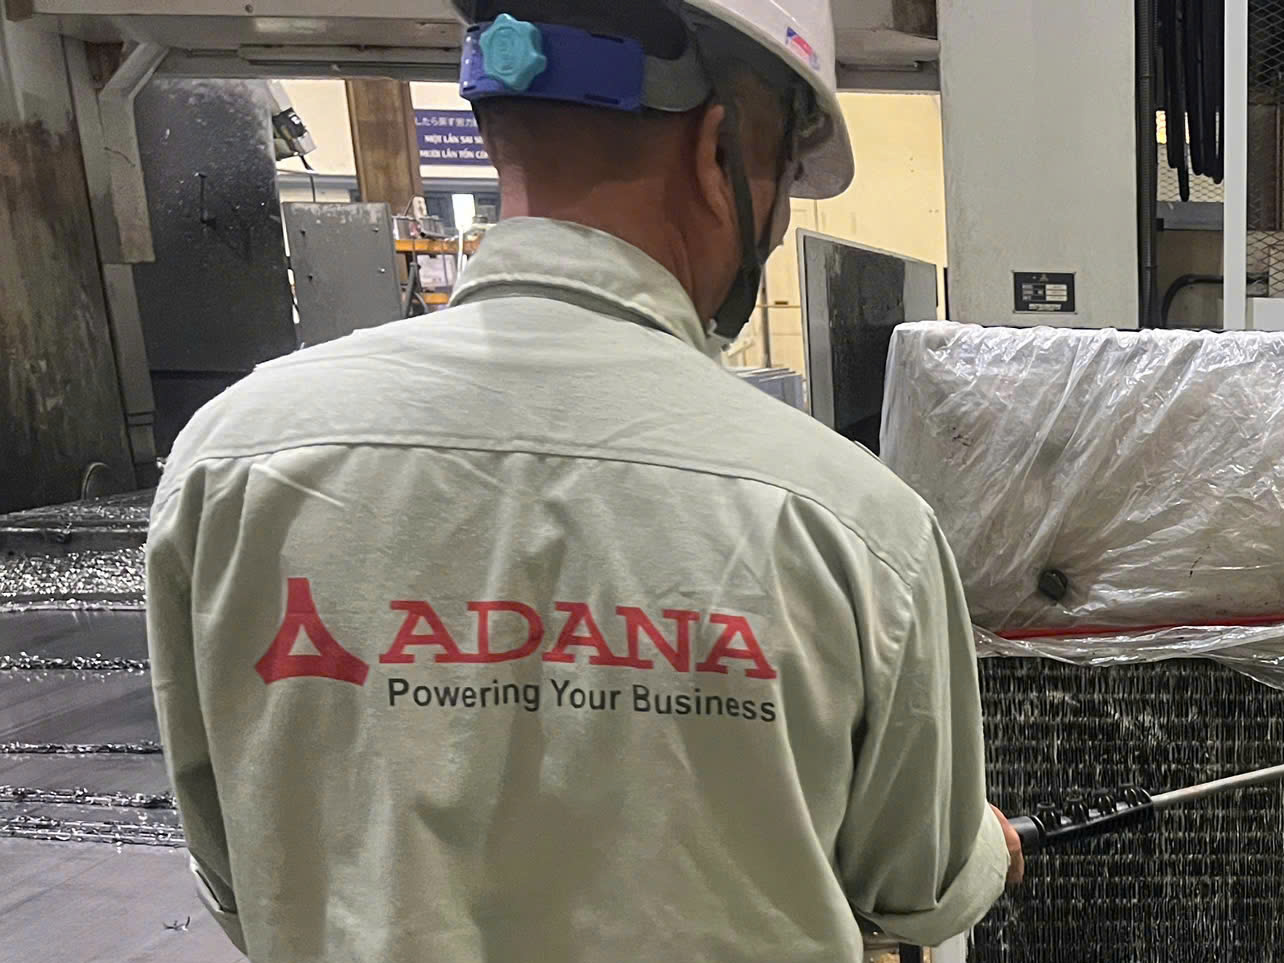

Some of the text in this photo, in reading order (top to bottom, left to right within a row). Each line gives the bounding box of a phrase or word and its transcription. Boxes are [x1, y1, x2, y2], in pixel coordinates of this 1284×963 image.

[379, 600, 777, 679] ADANA
[388, 678, 777, 722] Powering Your Business
